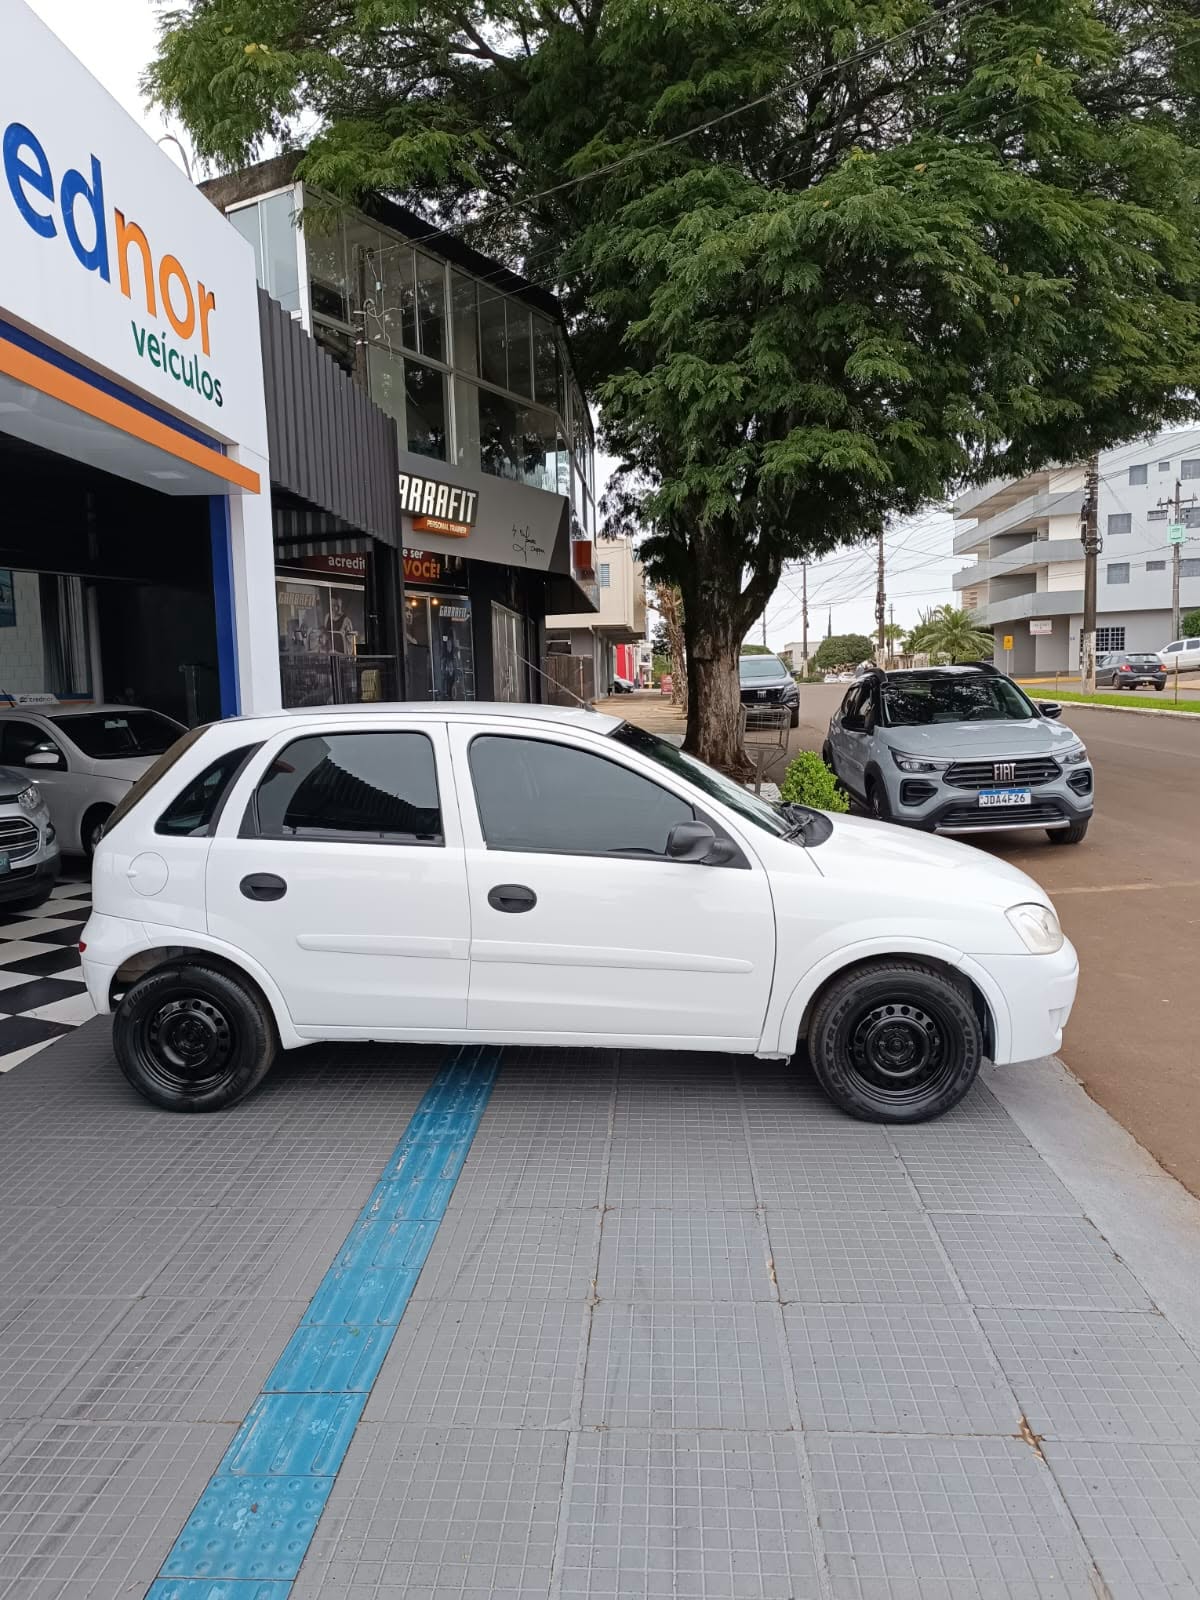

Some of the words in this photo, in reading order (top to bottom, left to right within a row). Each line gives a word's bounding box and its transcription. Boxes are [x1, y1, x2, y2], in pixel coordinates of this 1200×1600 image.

[3, 122, 215, 357] ednor
[131, 320, 223, 408] veículos
[410, 550, 424, 559] ser
[993, 763, 1016, 780] FIAT
[983, 794, 1026, 805] JDA4F26
